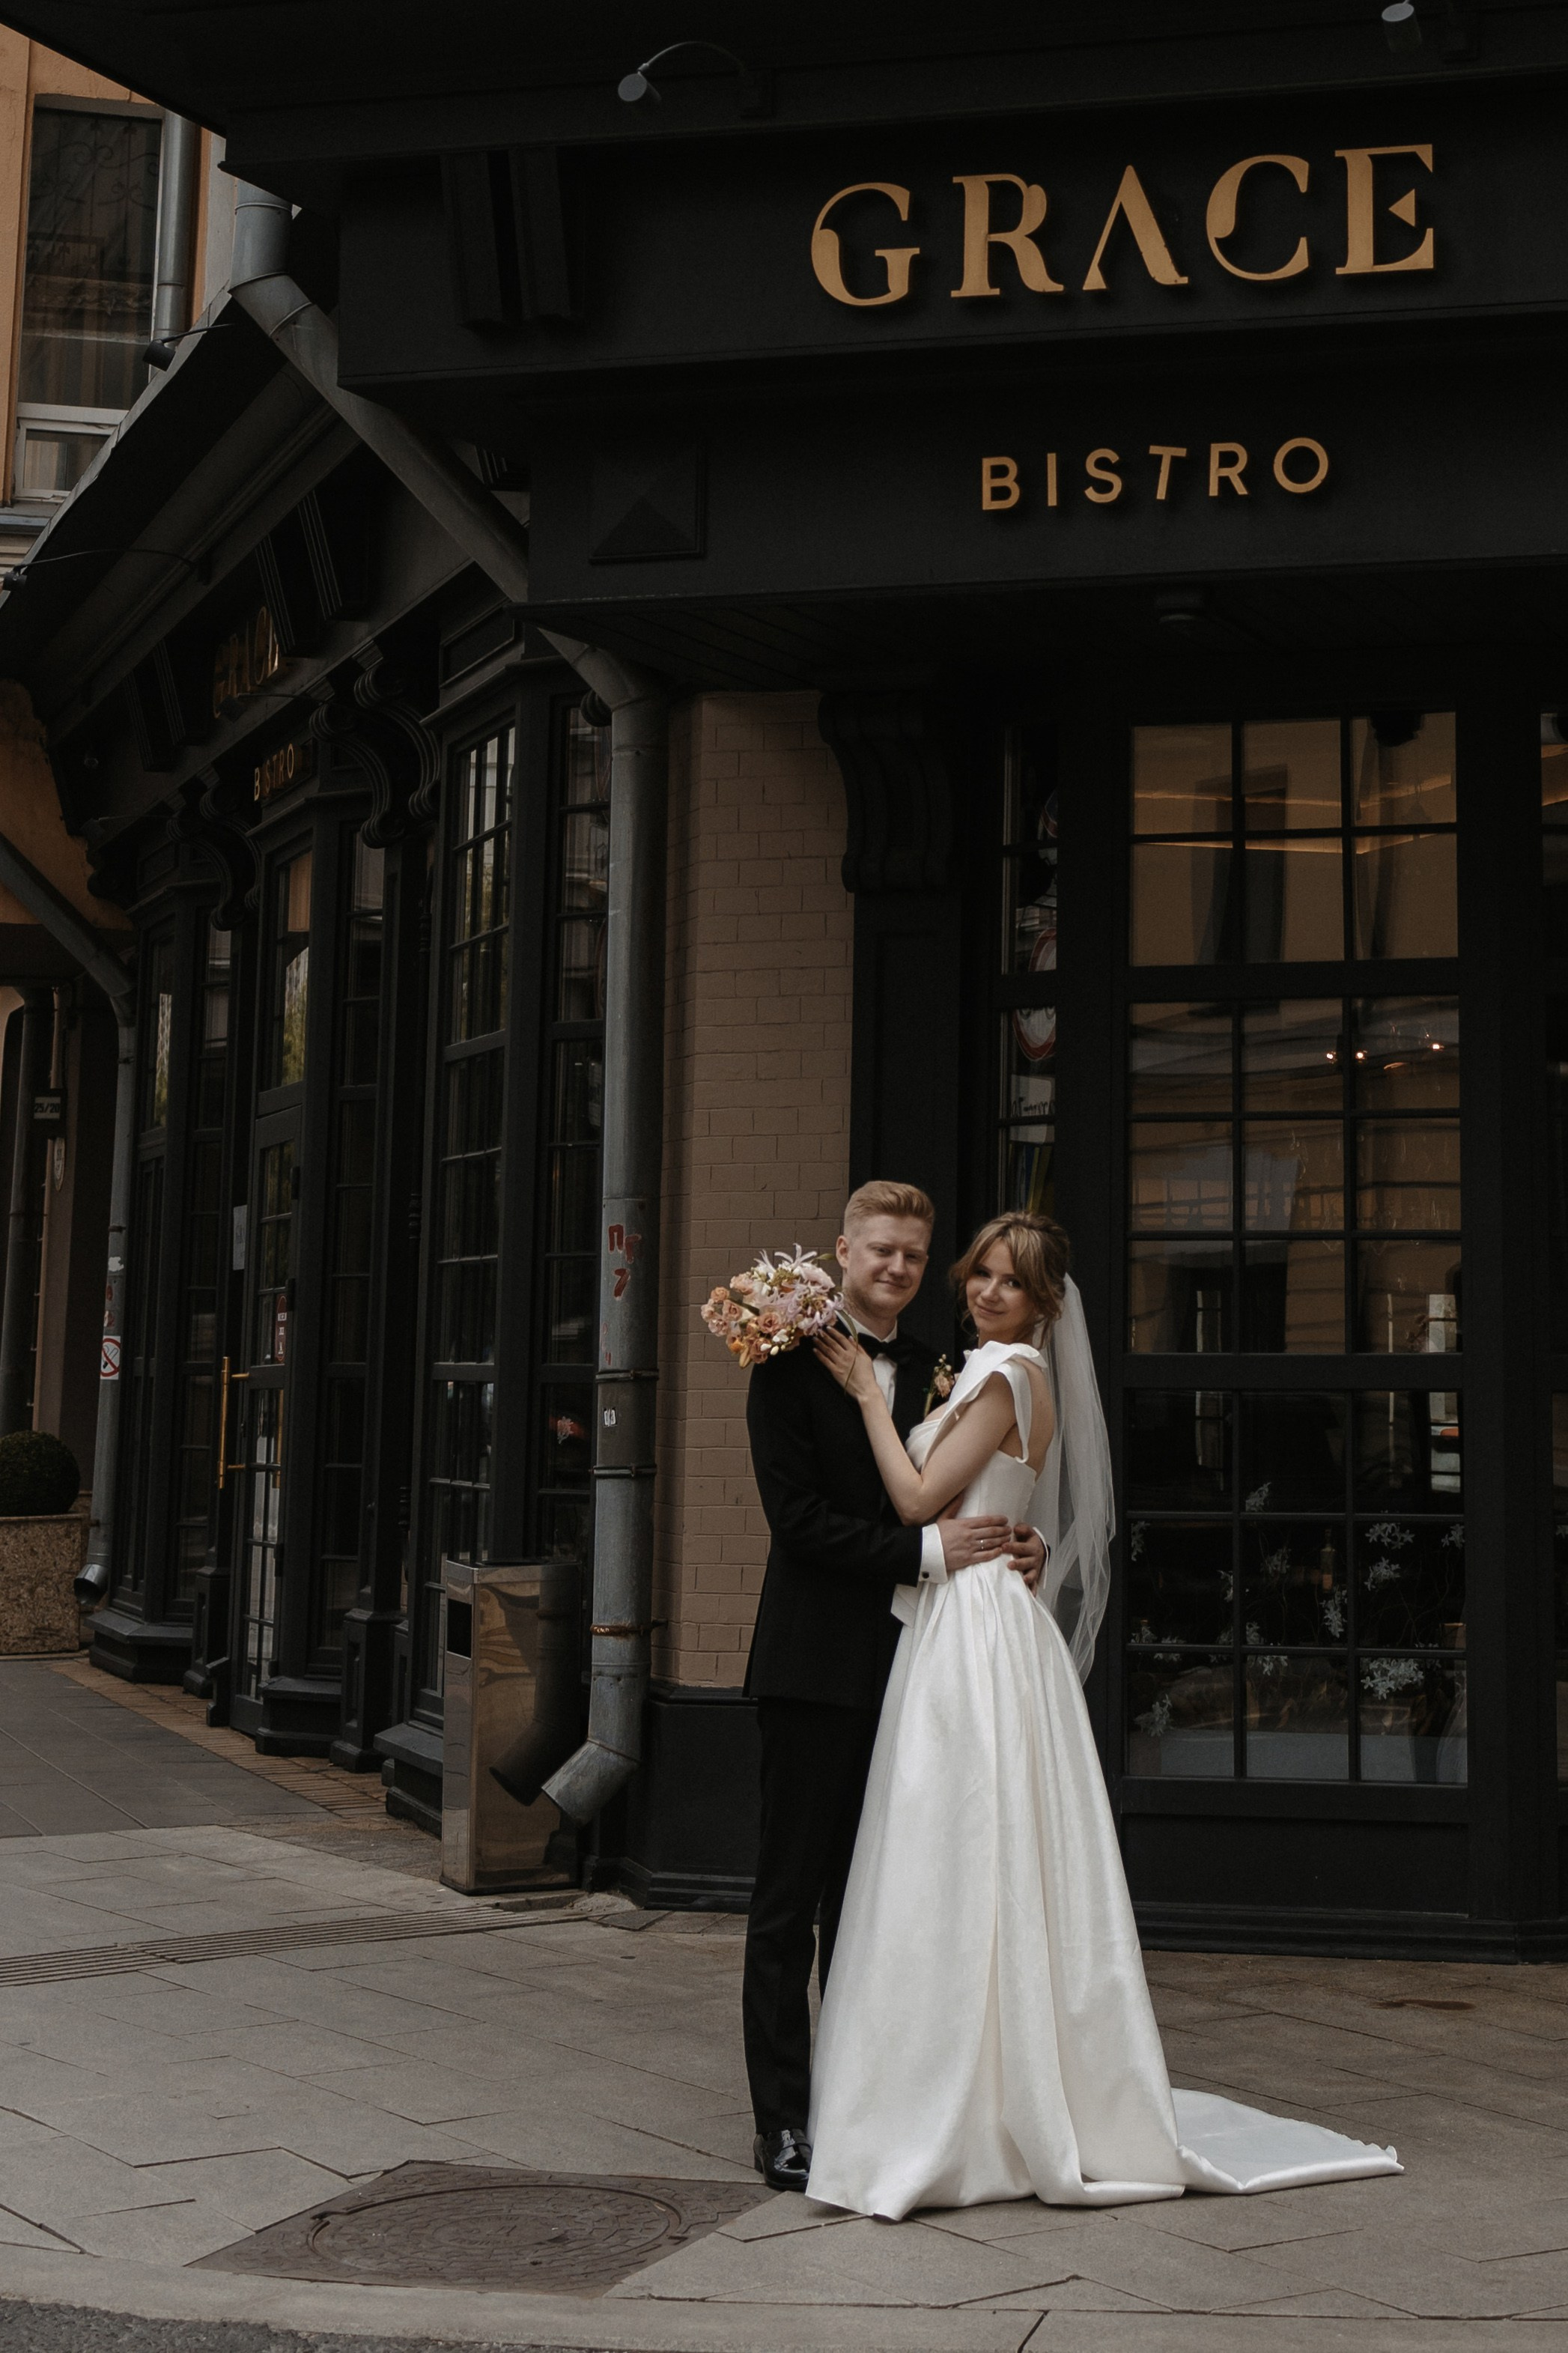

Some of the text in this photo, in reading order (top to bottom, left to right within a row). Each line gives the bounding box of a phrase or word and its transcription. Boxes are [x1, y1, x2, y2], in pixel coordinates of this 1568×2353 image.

[811, 144, 1434, 307] GRACE
[981, 437, 1329, 511] BISTRO
[254, 742, 294, 801] BSTRO
